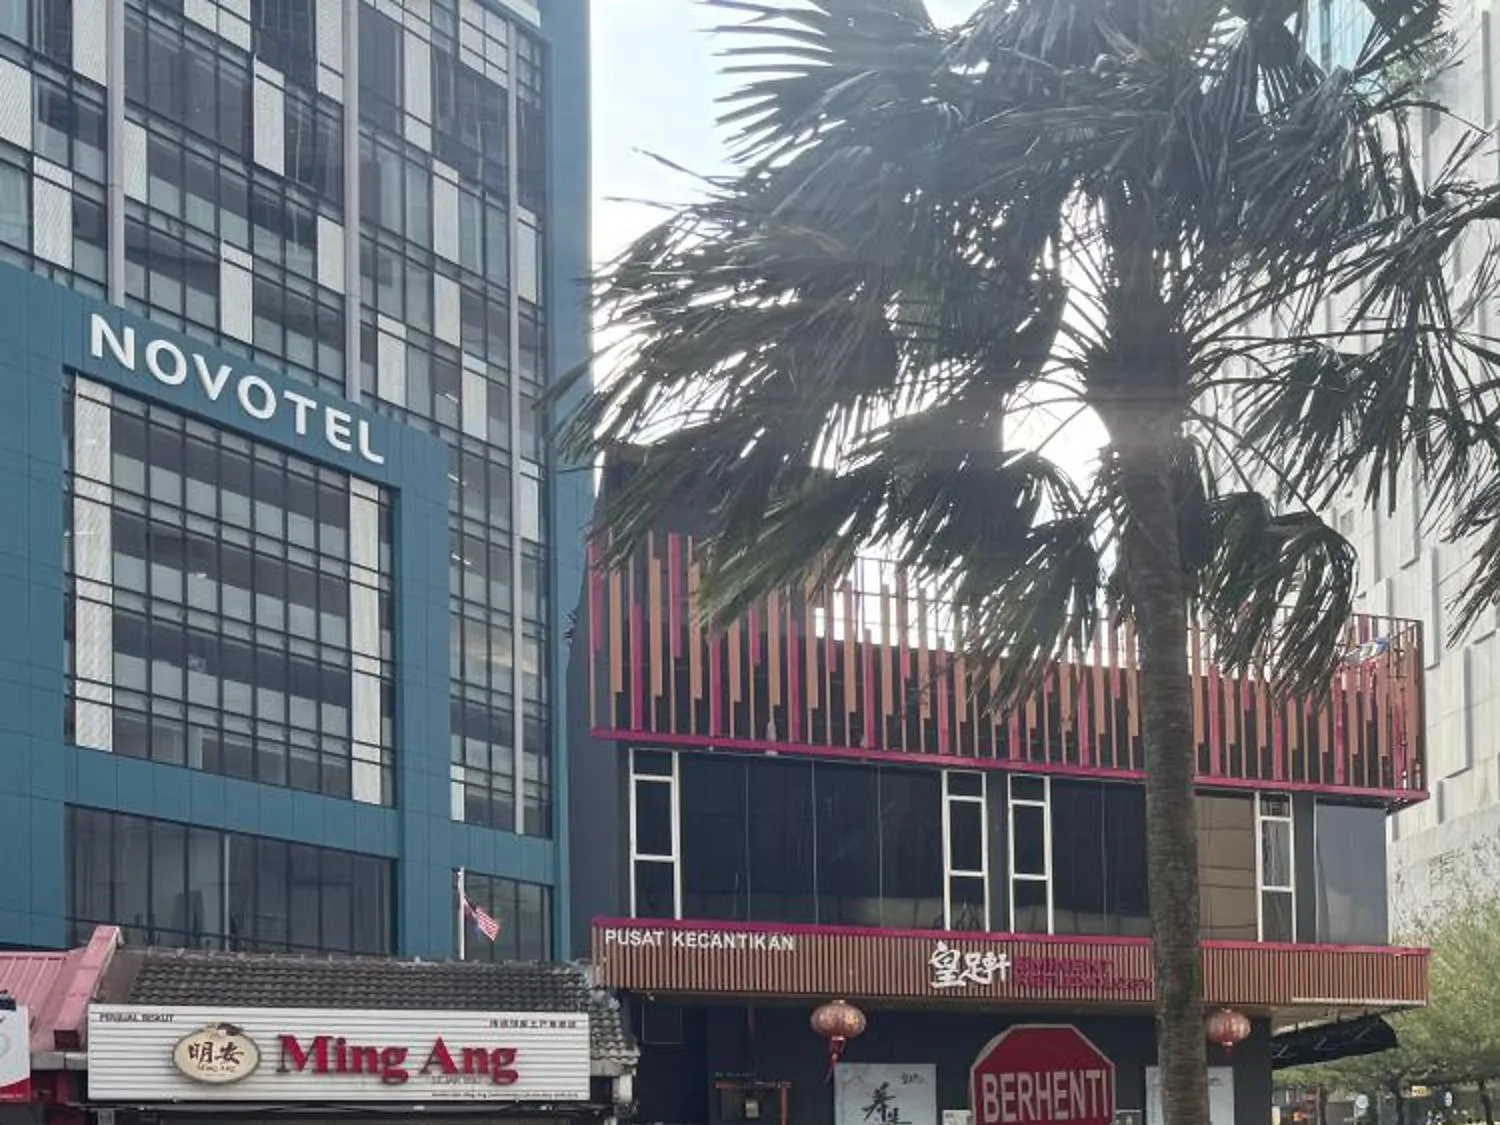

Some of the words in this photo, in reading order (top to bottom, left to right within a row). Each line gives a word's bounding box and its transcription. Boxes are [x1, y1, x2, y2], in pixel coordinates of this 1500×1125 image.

[91, 313, 384, 465] NOVOTEL
[605, 928, 665, 946] PUSAT
[671, 931, 795, 951] KECANTIKAN
[188, 1041, 245, 1065] 明安
[275, 1033, 410, 1085] Ming
[419, 1035, 519, 1086] Ang
[981, 1069, 1109, 1124] BERHENTI
